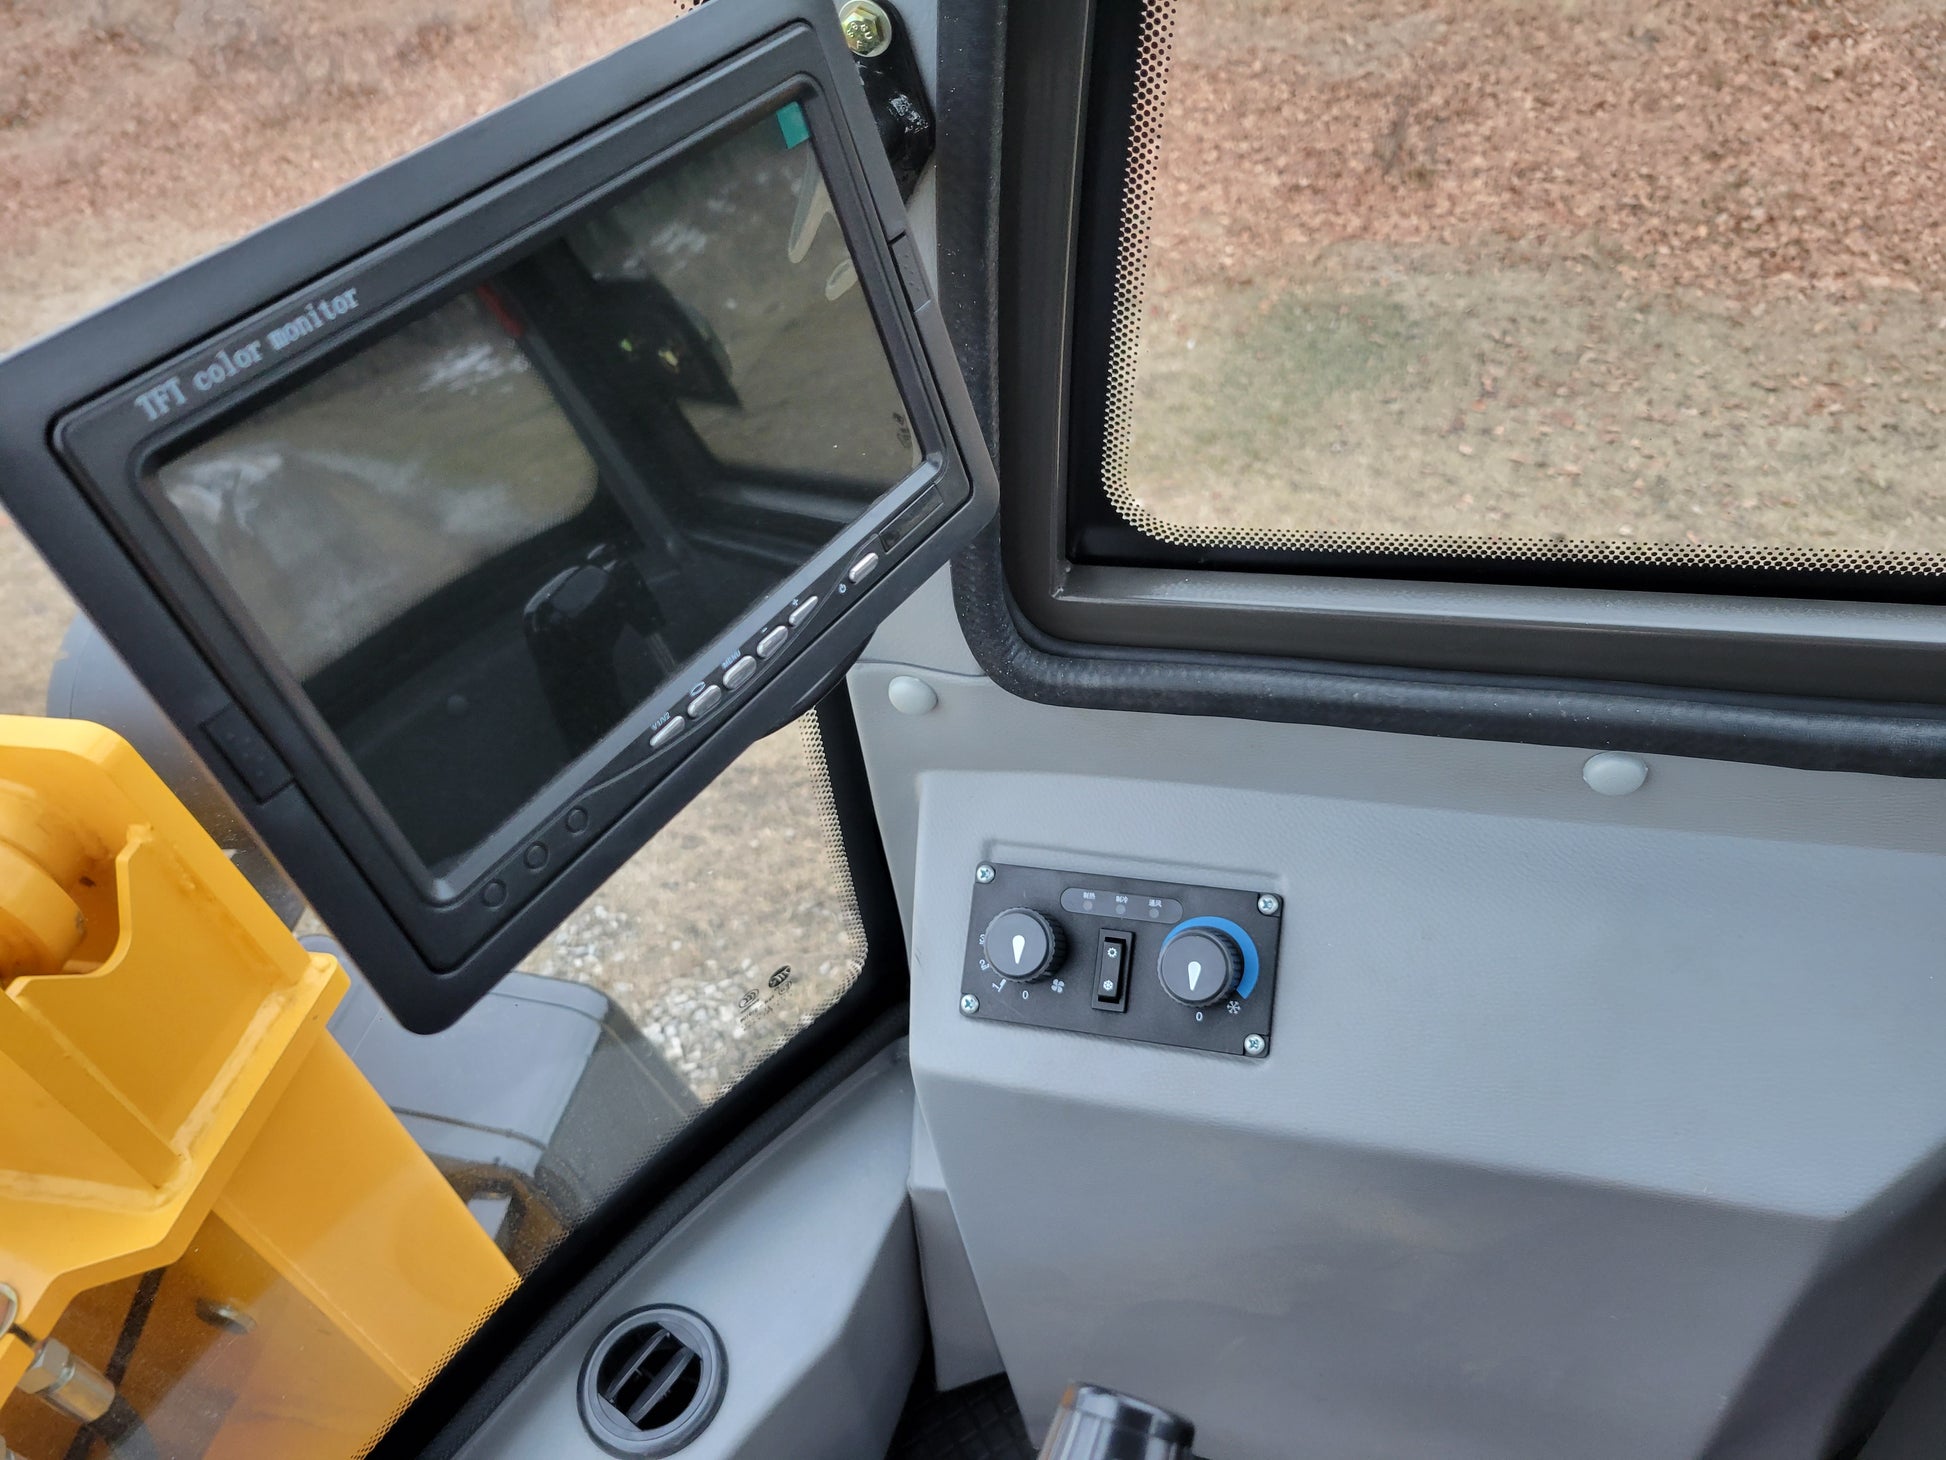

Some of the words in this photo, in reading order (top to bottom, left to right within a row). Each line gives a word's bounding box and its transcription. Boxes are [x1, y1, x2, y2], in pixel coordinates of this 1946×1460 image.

[134, 375, 188, 422] TFT
[192, 339, 264, 391] color
[266, 287, 360, 351] monitor
[1022, 990, 1029, 1000] 0
[1195, 1011, 1203, 1021] 0
